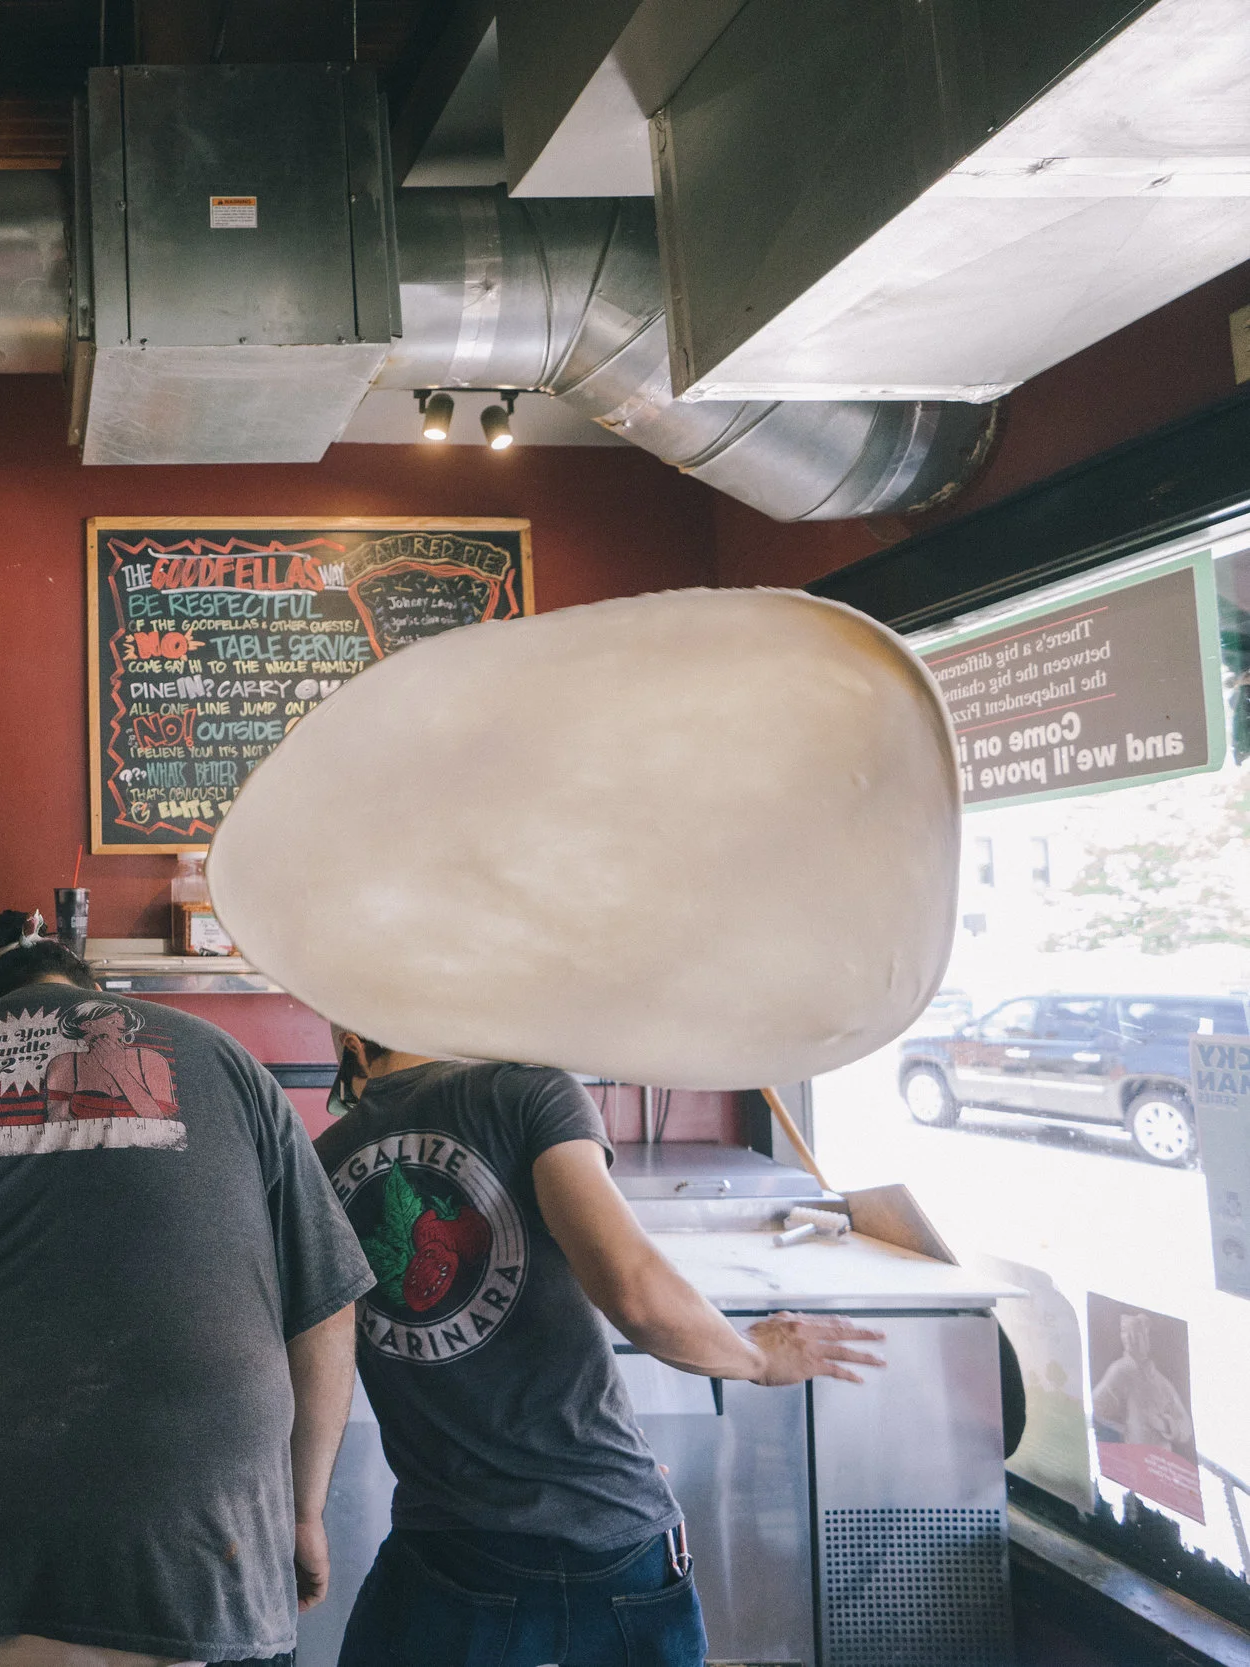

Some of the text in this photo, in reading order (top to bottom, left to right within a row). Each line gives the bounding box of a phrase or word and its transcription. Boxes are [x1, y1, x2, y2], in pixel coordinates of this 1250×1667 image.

[122, 556, 347, 592] THE GOODFELLAS WAY
[128, 592, 323, 620] BE RESPECTFUL
[128, 619, 146, 632] OF
[150, 619, 176, 632] THE
[181, 619, 260, 633] GOODFELLAS
[269, 619, 309, 632] OTHER
[134, 631, 190, 660] NO
[209, 634, 285, 661] TABLE
[288, 634, 371, 662] SERVICE
[128, 660, 365, 674] COME SAY HI TO THE WHOLE FAMILY!
[216, 678, 292, 699] CARRY
[294, 678, 350, 700] OU
[129, 702, 158, 717] ALL
[159, 702, 189, 716] ONE
[196, 702, 231, 716] LINE
[239, 701, 277, 717] JUMP
[284, 700, 305, 715] ON
[133, 707, 197, 749] NO!
[196, 719, 283, 742] OUTSIDE
[136, 747, 186, 759] BELIEVE
[242, 745, 263, 758] NOT
[194, 760, 238, 787] BETTER
[157, 800, 215, 819] ELITE
[14, 1026, 58, 1042] You
[331, 1139, 467, 1201] EGALIZE
